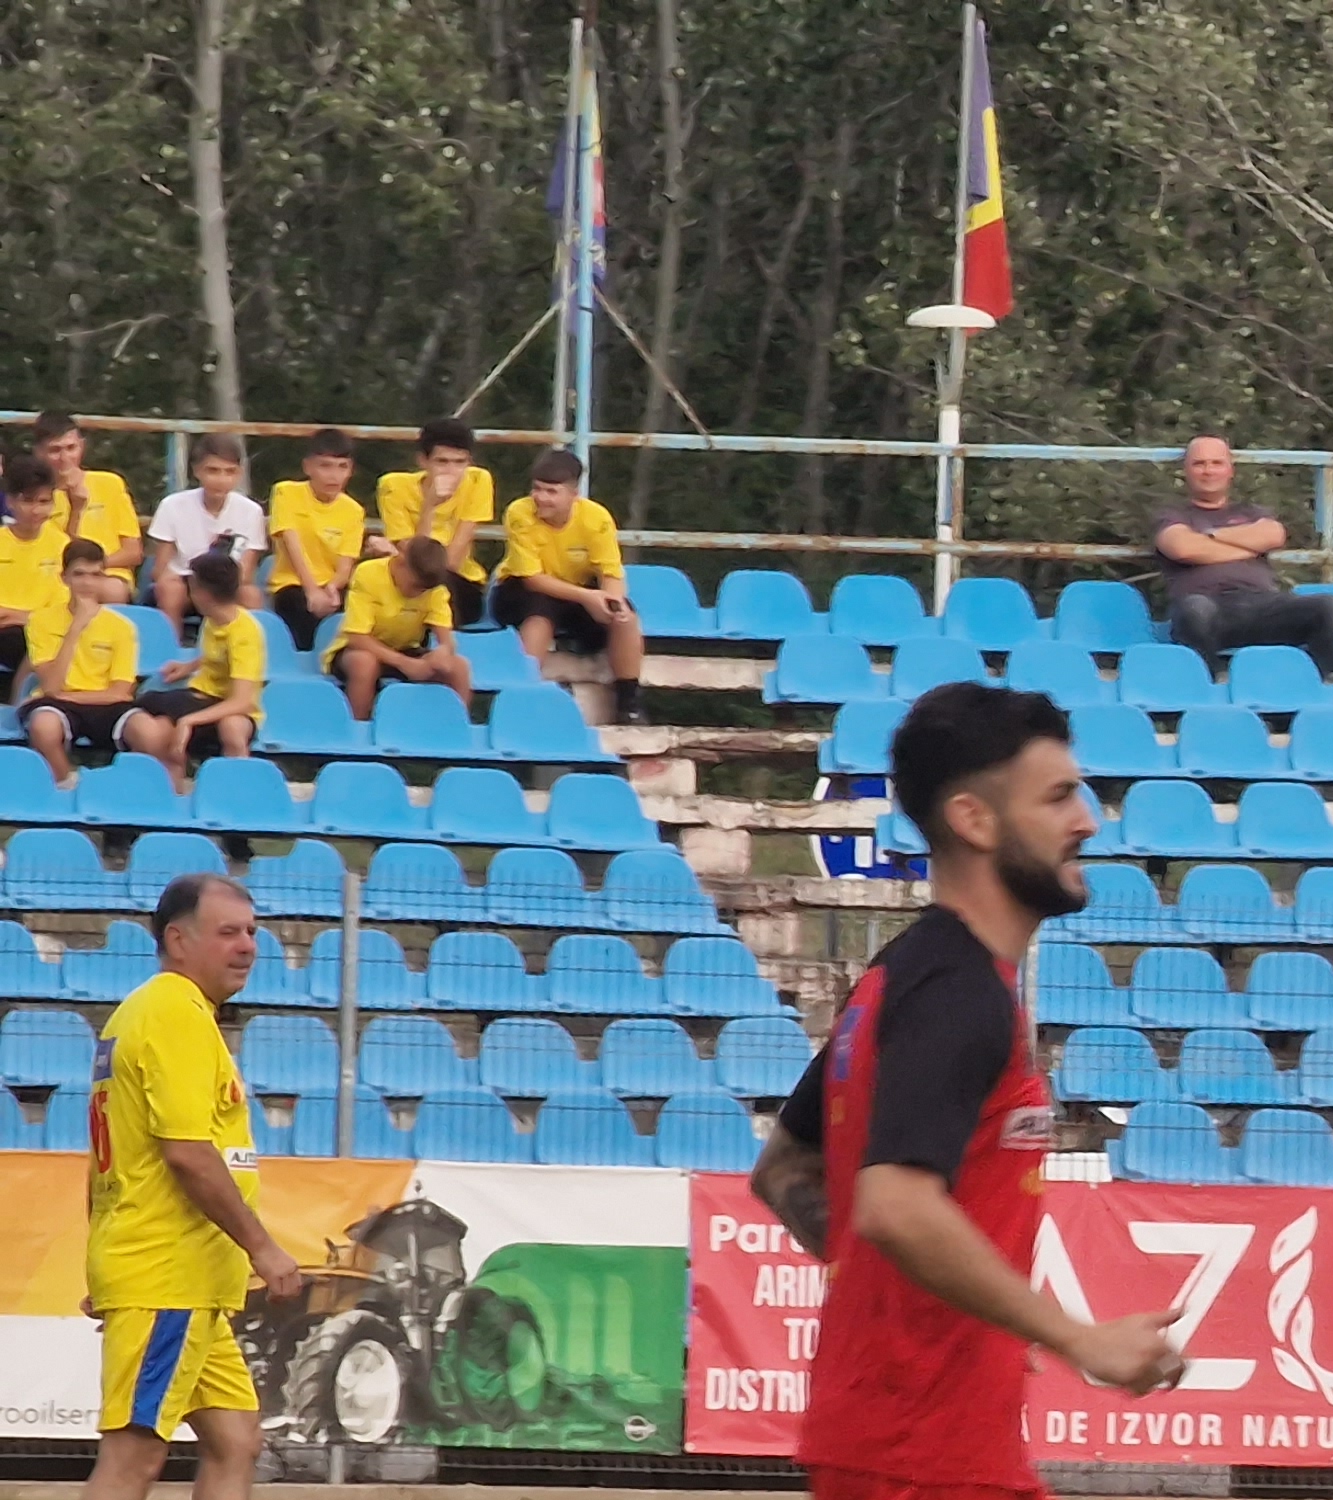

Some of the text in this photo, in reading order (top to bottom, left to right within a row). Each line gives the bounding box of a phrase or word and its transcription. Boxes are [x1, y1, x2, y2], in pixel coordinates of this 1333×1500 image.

[704, 1367, 812, 1413] DISTRI
[1045, 1410, 1090, 1444] DE
[1106, 1411, 1224, 1447] IZVOR
